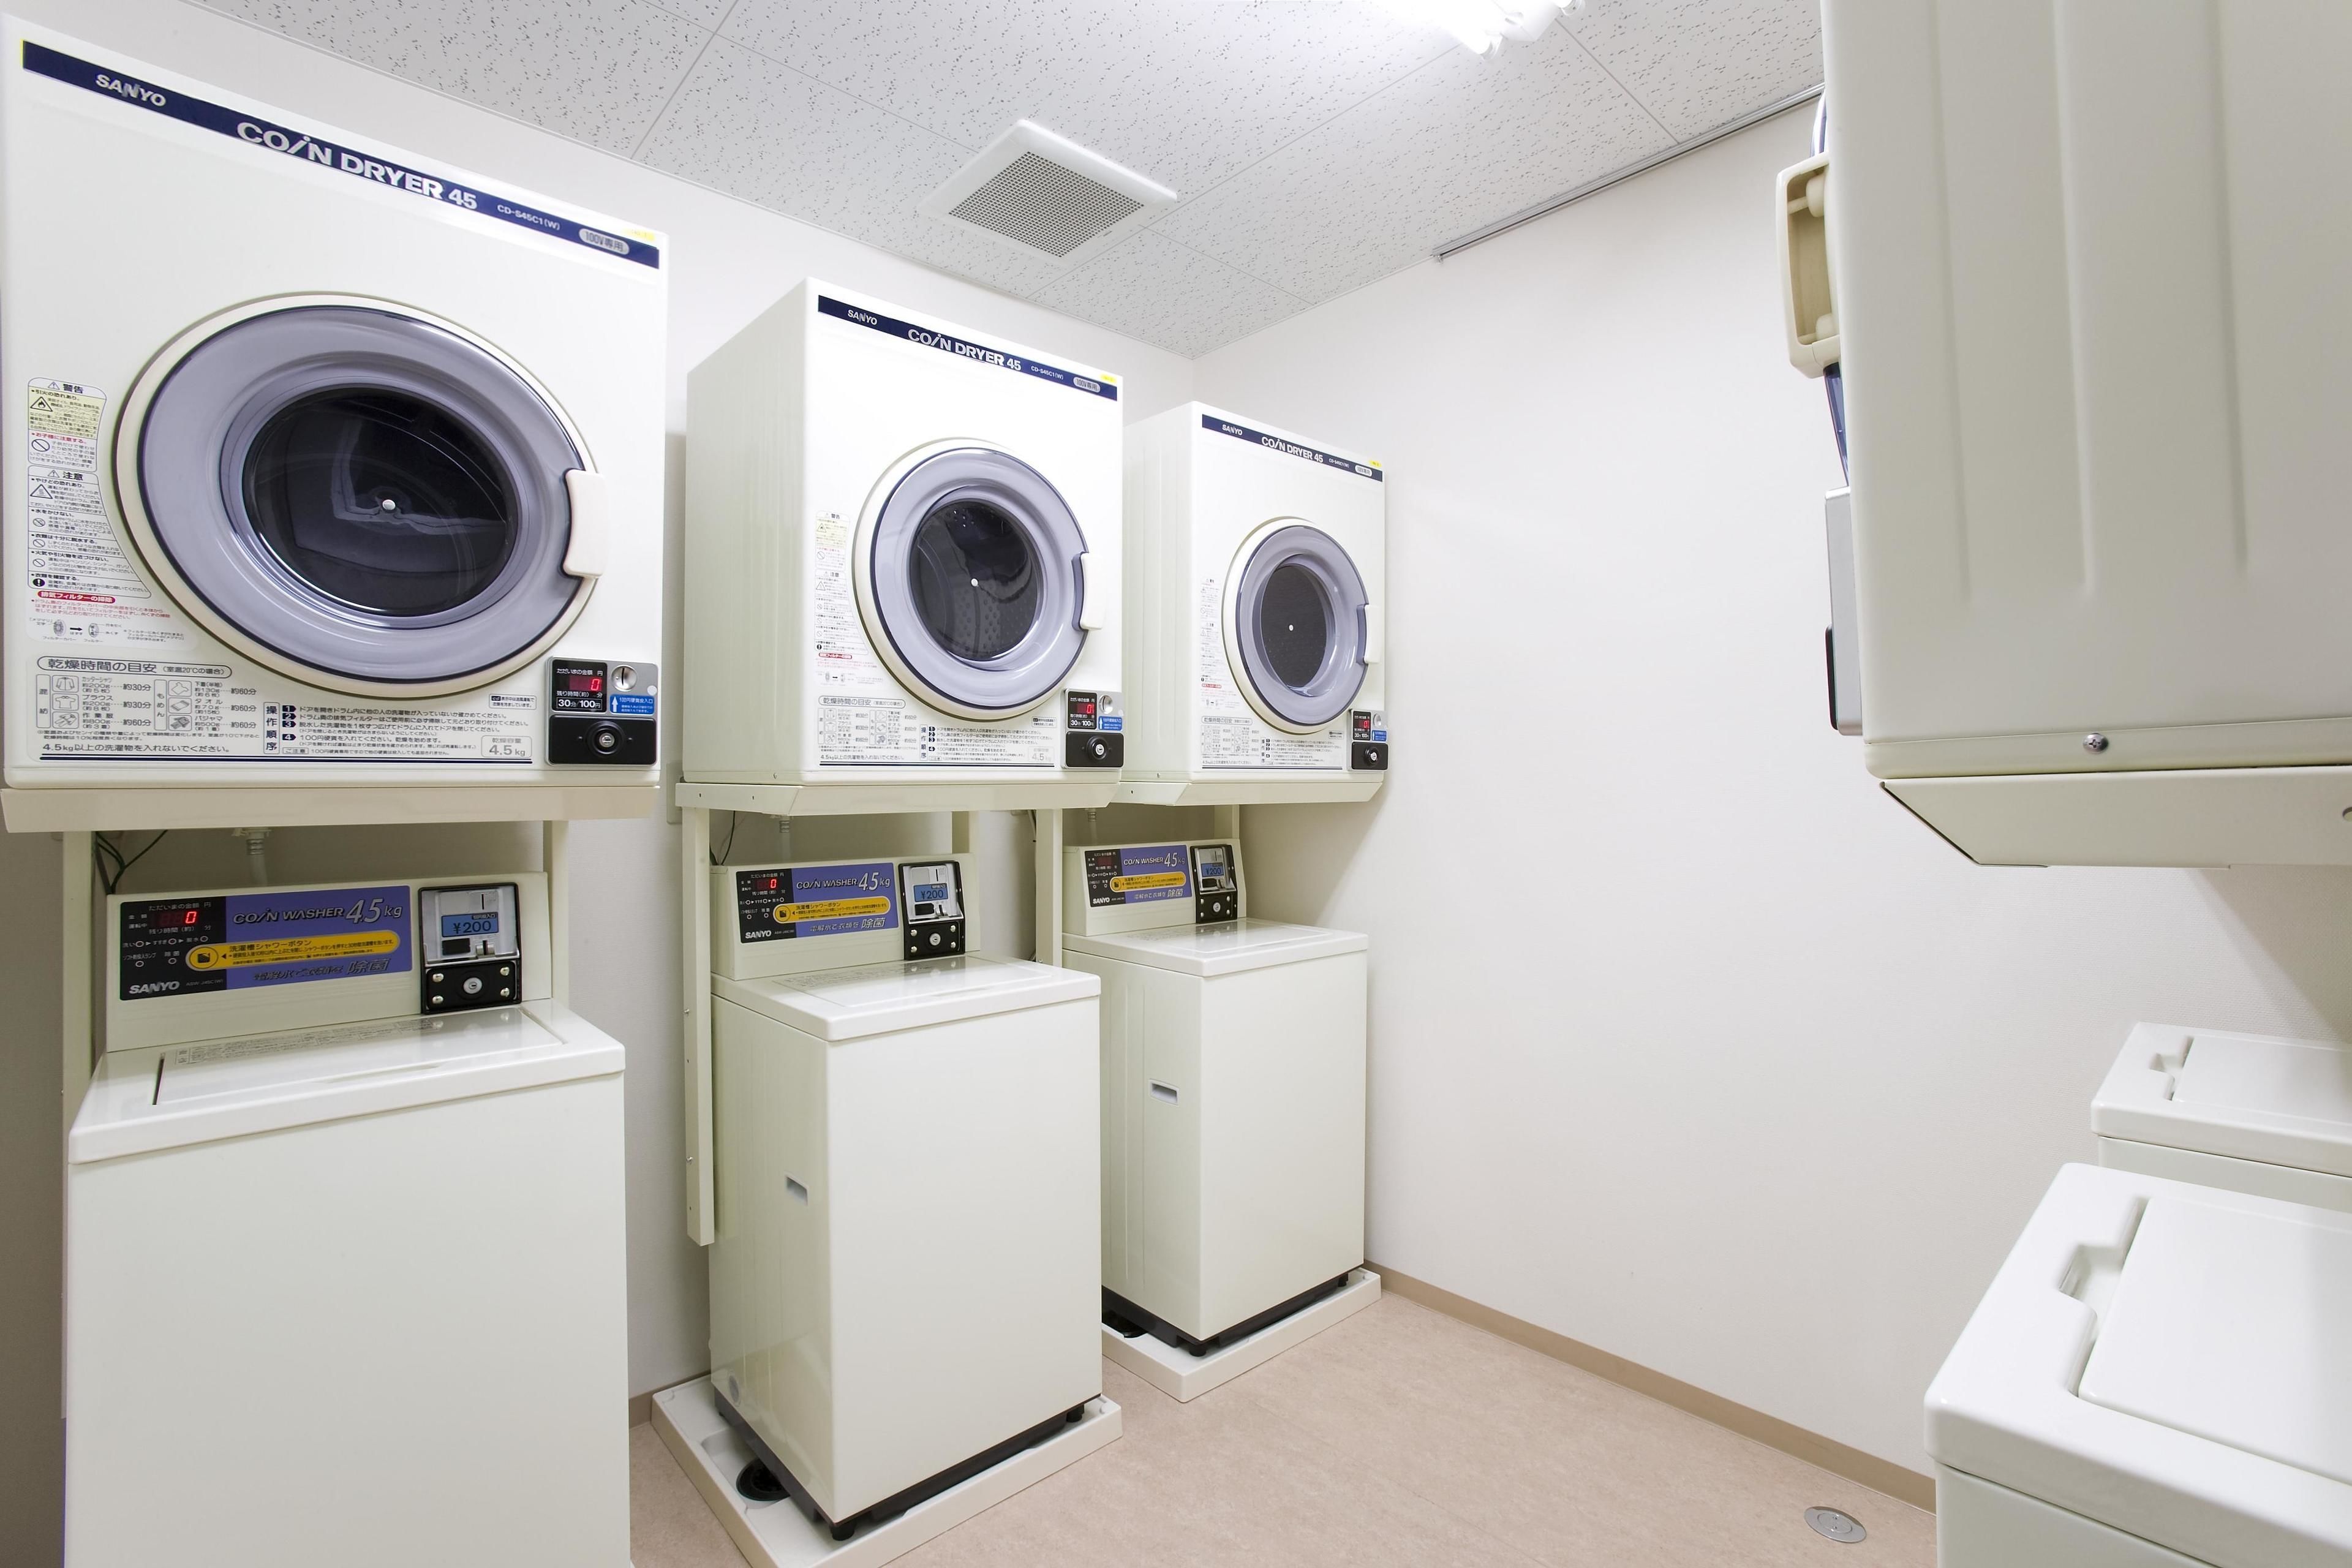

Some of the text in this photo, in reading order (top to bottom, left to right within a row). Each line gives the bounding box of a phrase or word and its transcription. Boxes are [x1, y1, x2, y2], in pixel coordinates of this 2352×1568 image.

[96, 74, 166, 107] SANYO
[341, 153, 444, 199] DRYER
[448, 189, 478, 209] 45
[497, 204, 560, 230] CD-S45C1(W)
[848, 309, 877, 325] SANYO
[955, 342, 1005, 366] DRYER
[1007, 358, 1021, 371] 45
[1031, 366, 1064, 380] CD-S45C1(W)
[63, 383, 83, 394] 警告
[1222, 424, 1243, 435] SANYO
[36, 432, 86, 443] お子様に注意する。
[1287, 446, 1313, 461] DRYER
[1314, 453, 1324, 463] 45
[63, 472, 83, 480] 注意
[36, 533, 98, 544] 衣類は十分に脱水する。
[36, 551, 109, 562] 火気や引火物を近づけない。
[36, 573, 80, 581] 衣類を確認する。
[41, 592, 115, 604] 排気フィルターの掃除
[48, 658, 157, 673] 乾燥時間の目安
[123, 683, 151, 692] 約30分
[590, 678, 600, 691] 0
[266, 706, 277, 750] 操作順序
[42, 744, 229, 753] 4.5kg以上の洗濯物を入れないでください。
[489, 745, 512, 755] 4.5
[1205, 867, 1221, 875] ¥200
[770, 879, 777, 888] 0
[823, 878, 857, 887] WASHER
[921, 889, 944, 900] ¥200
[149, 902, 199, 911] ただいまの金額
[185, 911, 197, 924] 0
[282, 907, 345, 921] WASHER
[453, 921, 491, 933] ¥200
[861, 918, 885, 929] 除菌
[745, 930, 772, 939] SANYO
[229, 940, 312, 952] 洗濯槽シャワーボタン
[347, 958, 391, 974] 除菌
[129, 981, 180, 994] SANYO
